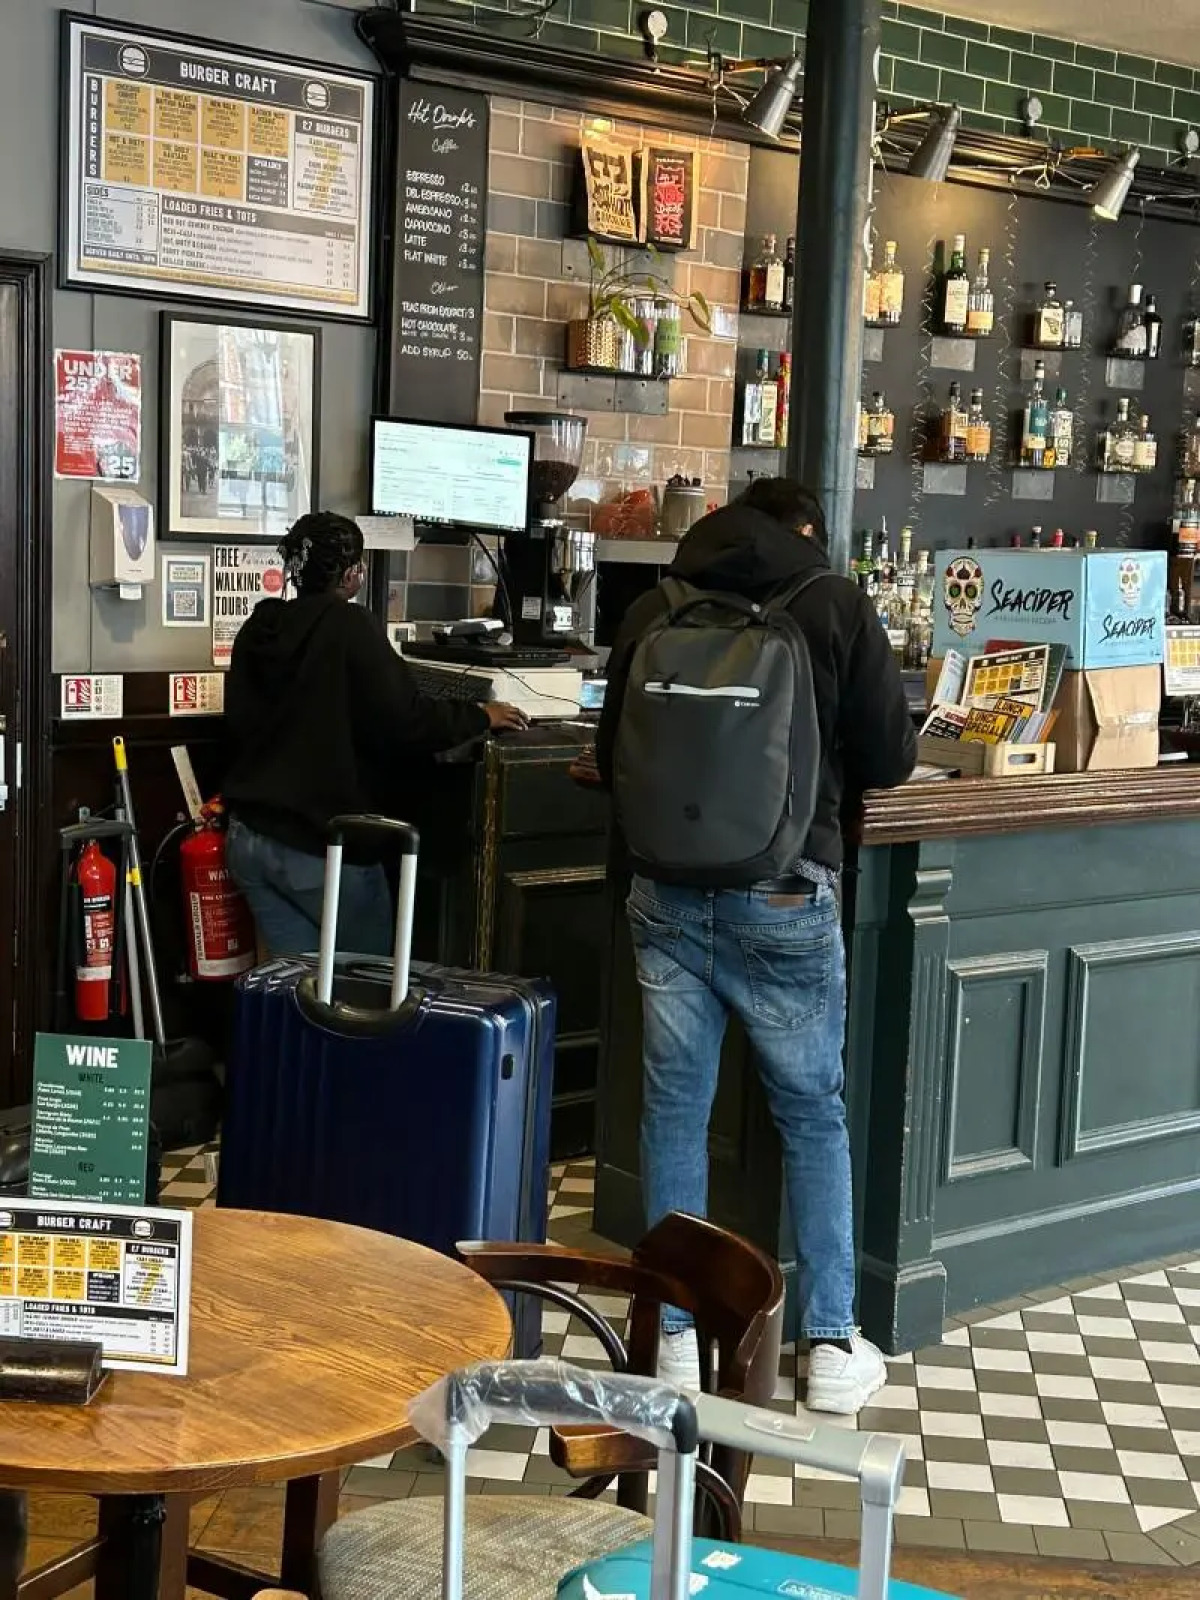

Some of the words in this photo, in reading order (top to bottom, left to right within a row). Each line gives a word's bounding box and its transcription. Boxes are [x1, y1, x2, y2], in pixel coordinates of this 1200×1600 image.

[179, 62, 230, 86] BURGER
[235, 72, 277, 95] CRAFT
[407, 98, 431, 123] Hot
[315, 123, 349, 139] BURGERS
[405, 170, 445, 186] ESPRESSO
[421, 189, 460, 206] ESPRESSO
[163, 199, 197, 214] LOADED
[200, 204, 224, 218] FRIES
[237, 209, 257, 223] TOTS
[405, 202, 453, 219] AMERICANO
[404, 217, 451, 235] CAPPUCCINO
[404, 233, 428, 247] LATTE
[404, 249, 423, 261] FLAT
[424, 252, 448, 266] WHITE
[402, 301, 419, 313] TEAS
[420, 303, 438, 316] FROM
[402, 317, 418, 330] HOT
[417, 320, 459, 333] CHOCOLATE
[401, 344, 421, 355] ADD
[422, 346, 452, 358] SYRUP
[63, 359, 133, 381] UNDER
[107, 455, 136, 476] 25
[215, 547, 240, 568] FREE
[215, 572, 261, 592] WALKING
[215, 596, 249, 616] TOURS
[996, 698, 1025, 715] LUNCH
[969, 709, 997, 724] LUNCH
[65, 1044, 119, 1068] WINE
[78, 1072, 104, 1084] WHITE
[77, 1161, 95, 1173] RED
[37, 1215, 76, 1229] BURGER
[79, 1217, 112, 1231] CRAFT
